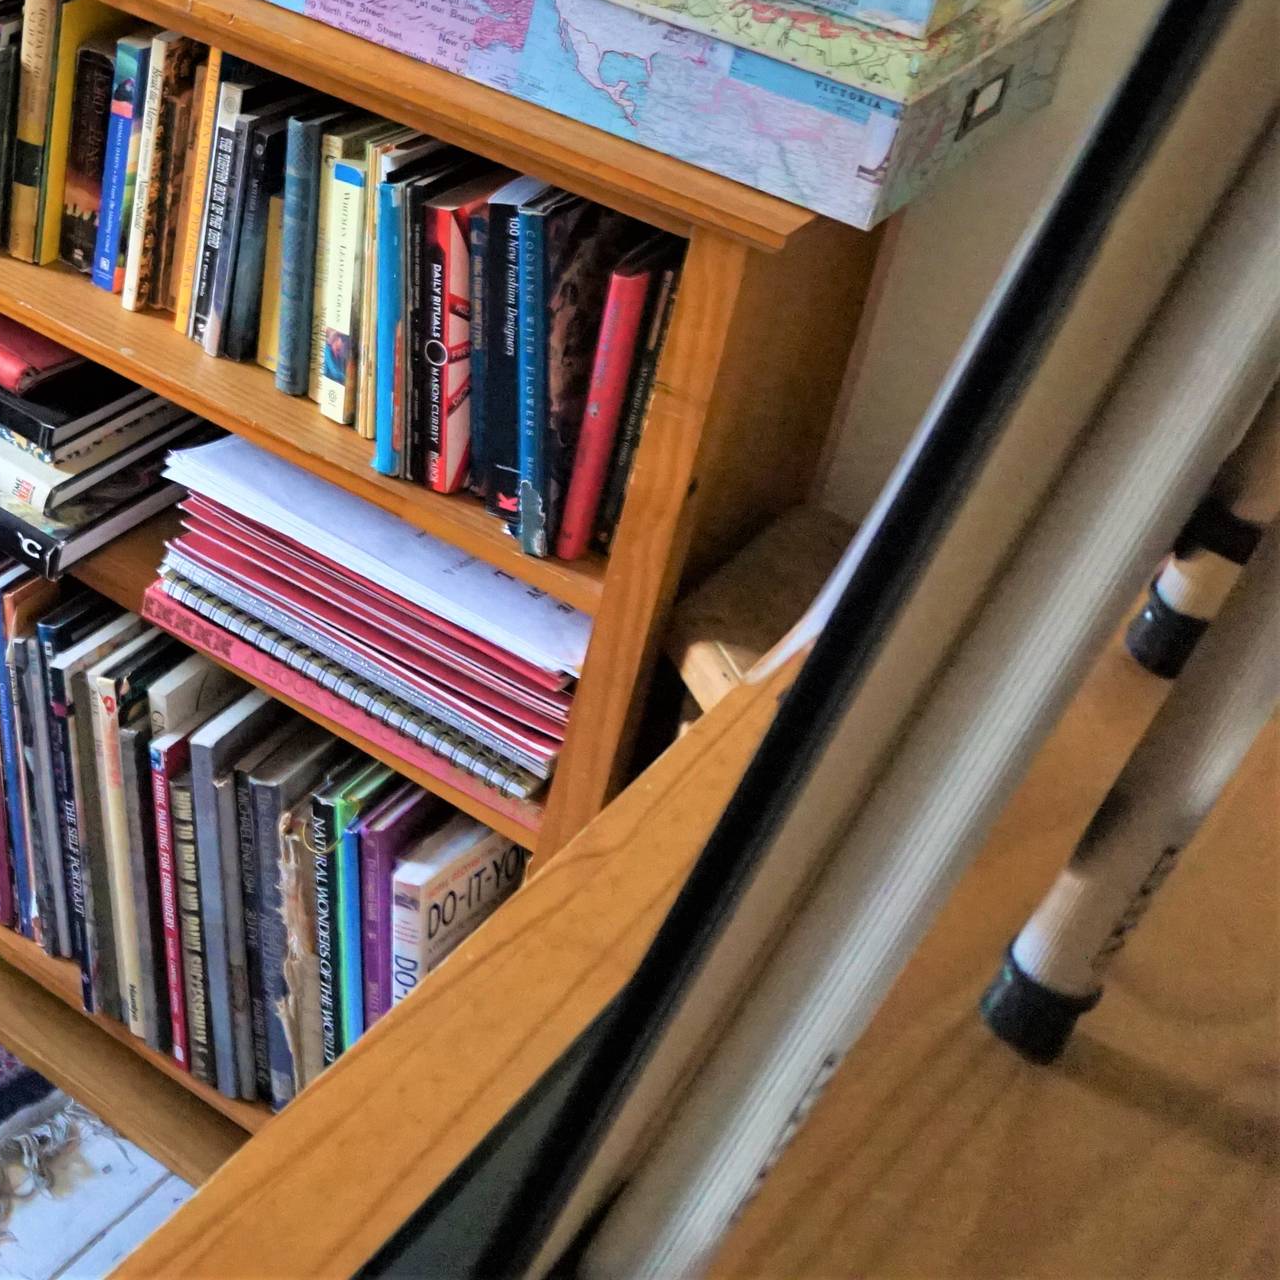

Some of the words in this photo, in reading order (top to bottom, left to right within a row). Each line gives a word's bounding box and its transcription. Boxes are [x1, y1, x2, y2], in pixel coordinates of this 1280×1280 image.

[345, 10, 372, 28] Fourth
[438, 32, 457, 47] New
[814, 79, 882, 110] VICTORIA
[212, 184, 226, 203] BOOK
[509, 216, 520, 236] 100
[508, 238, 518, 262] New
[526, 230, 535, 304] COOKING
[432, 263, 442, 294] DAILY
[506, 263, 519, 304] Fashion
[431, 295, 442, 338] RITUALS
[503, 305, 517, 356] Designers
[526, 316, 535, 354] WITH
[431, 367, 441, 403] MASON
[525, 366, 535, 437] FLOWERS
[430, 404, 440, 444] CURREY
[155, 773, 166, 805] FABRIC
[64, 800, 76, 824] THE
[67, 825, 79, 852] SELF
[157, 809, 169, 850] PAINTING
[177, 822, 194, 839] TO
[160, 852, 171, 870] FOR
[177, 844, 197, 881] DRAW
[312, 817, 328, 883] NATURAL
[69, 853, 85, 916] PORTRAIT
[162, 872, 175, 931] EMBROIDERY
[181, 884, 199, 911] AND
[316, 885, 331, 957] WONDERS
[320, 959, 332, 976] OF
[321, 977, 333, 1005] THE
[322, 1006, 336, 1063] WORLD
